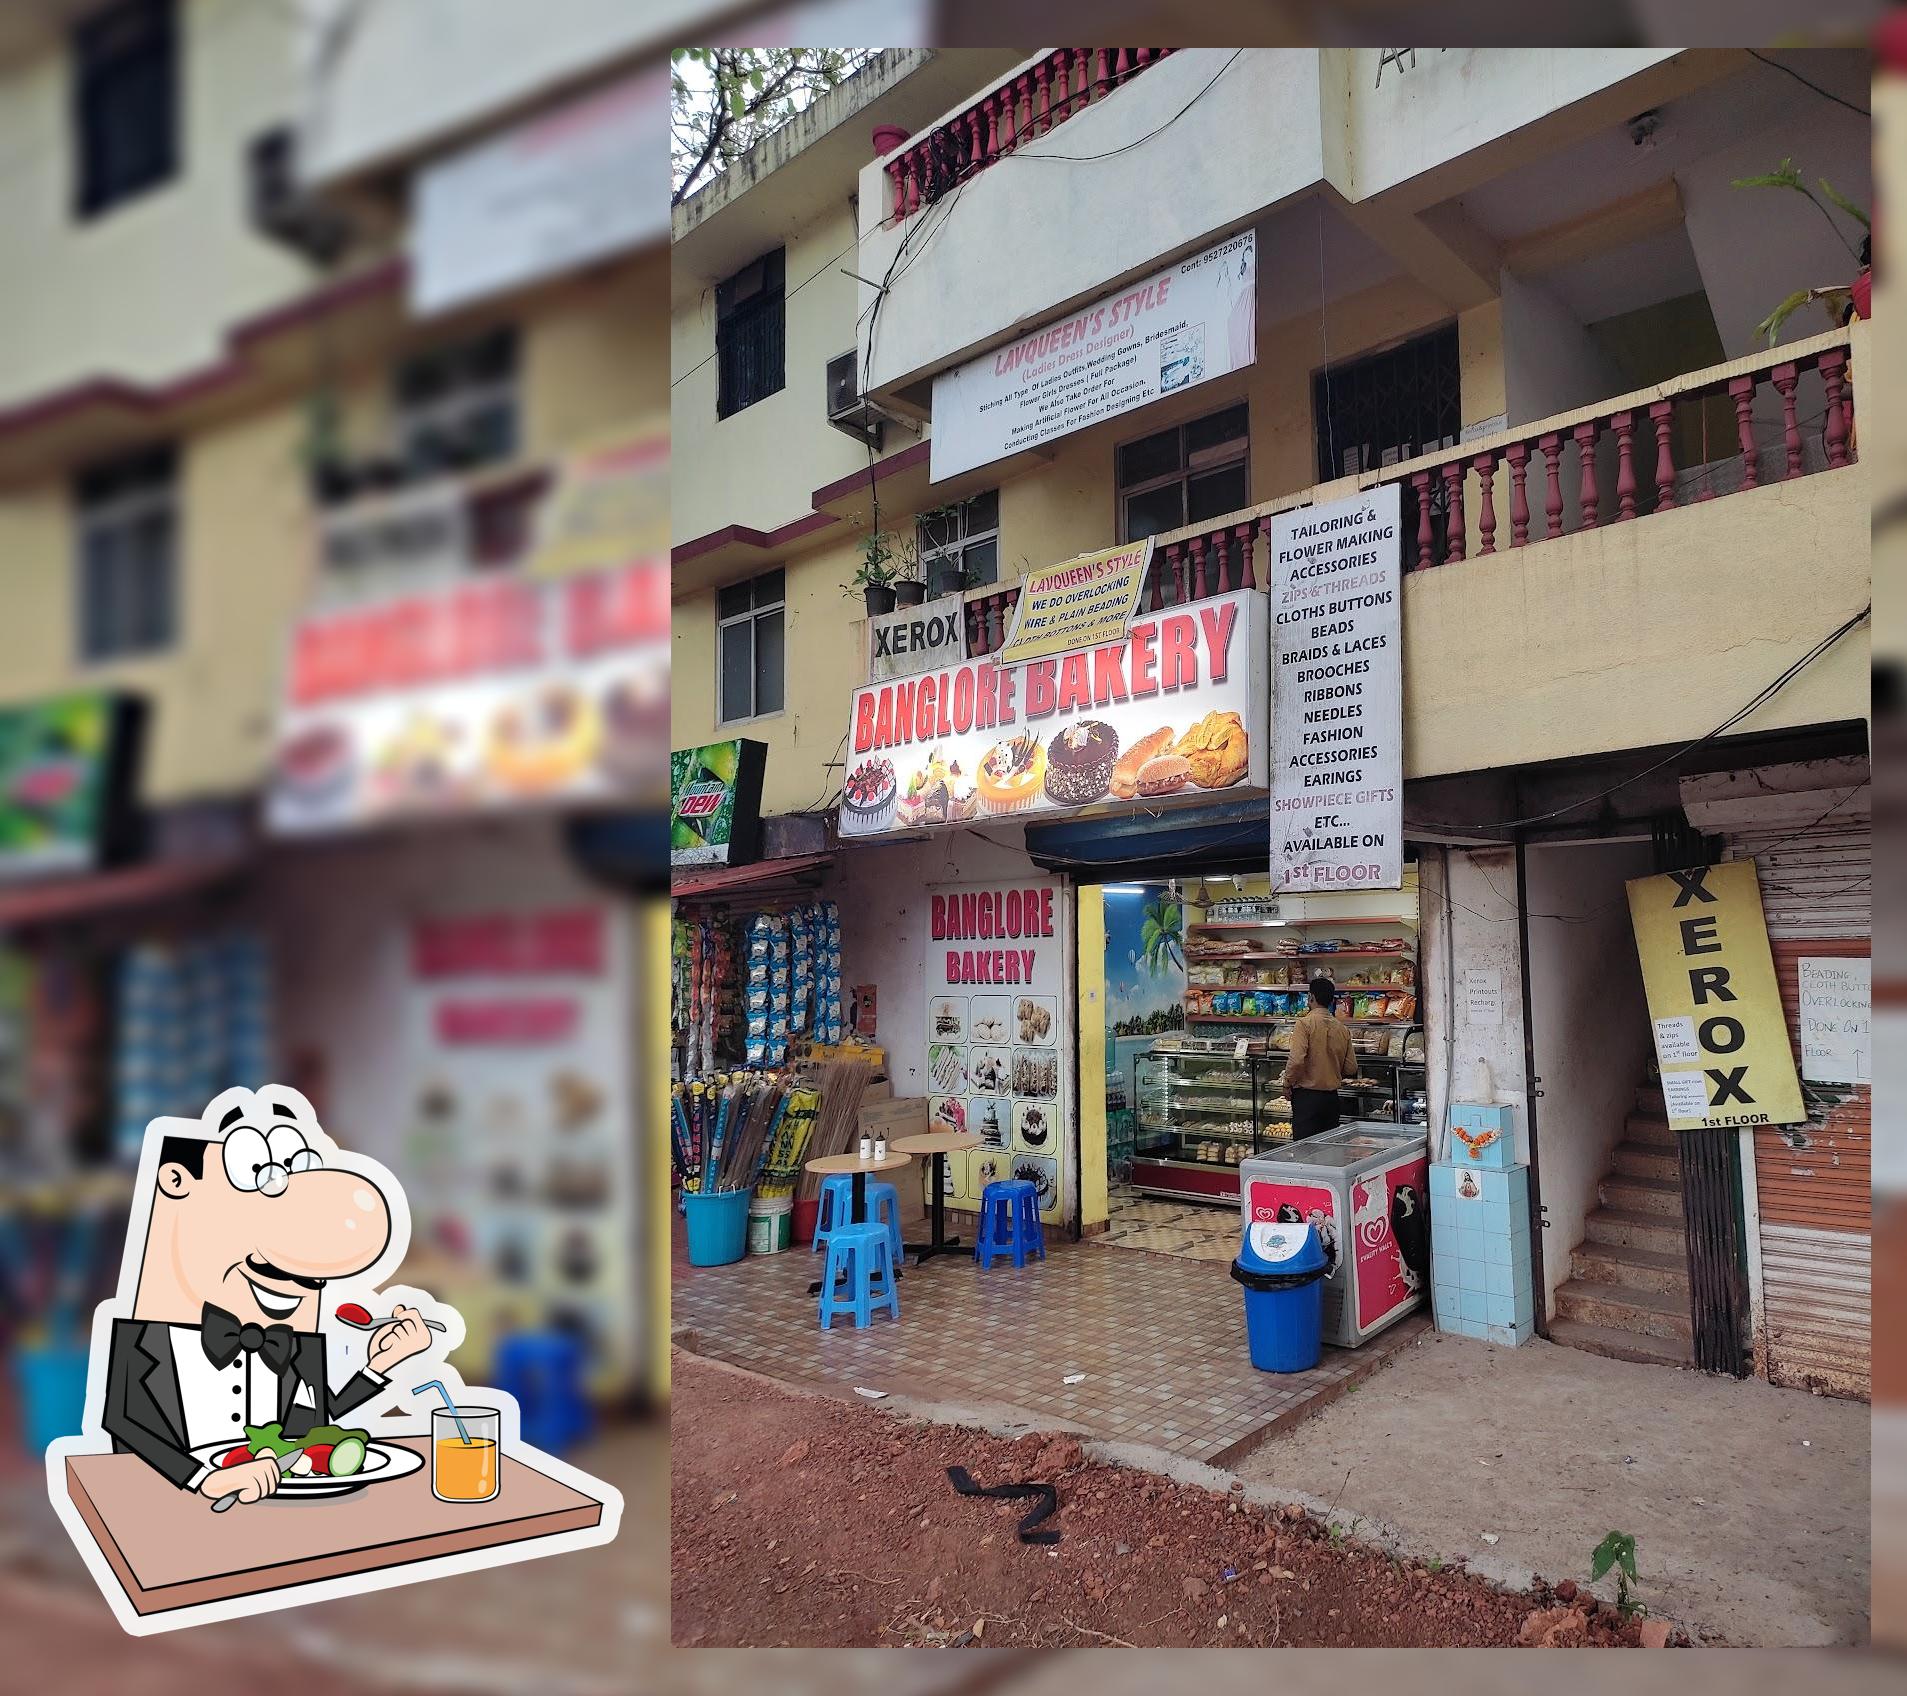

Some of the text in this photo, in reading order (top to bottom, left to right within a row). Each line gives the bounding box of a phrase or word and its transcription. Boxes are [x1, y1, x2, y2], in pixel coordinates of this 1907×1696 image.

[1181, 233, 1253, 275] Cont: 9527220676
[994, 307, 1105, 377] LAVQUEEN'S
[1108, 276, 1172, 329] STYLE
[1022, 359, 1056, 383] (Ladies
[1058, 347, 1084, 367] Dress
[1086, 323, 1135, 355] Designer)
[1004, 394, 1013, 403] All
[1014, 388, 1029, 400] Type
[1031, 382, 1039, 391] Of
[1040, 374, 1062, 388] Ladies
[1019, 396, 1041, 409] Flower
[1042, 388, 1057, 400] Girls
[1058, 377, 1085, 393] Dresses
[1090, 368, 1103, 380] Full
[1104, 355, 1137, 377] Package)
[1038, 377, 1115, 413] We Also Take Order For
[1004, 388, 1155, 450] Conducting Classes For Fashion Designing Etc
[1011, 422, 1034, 435] Making
[1035, 412, 1061, 427] Artificial
[1063, 401, 1086, 415] Flower
[1087, 396, 1099, 407] For
[1100, 390, 1110, 401] All
[1291, 509, 1377, 541] TAILORING &
[1279, 525, 1393, 563] FLOWER MAKING
[1029, 549, 1141, 593] LAVQUEEN'S STYLE
[1289, 551, 1378, 582] ACCESSORIES
[1031, 575, 1130, 611] WE DO OVERLOCKING
[1281, 570, 1386, 604] ZIPS & THREADS
[1024, 593, 1129, 629] WIRE & PLAIN BEADING
[1097, 611, 1128, 626] MORE
[1276, 590, 1393, 625] CLOTHS BUTTONS
[875, 611, 959, 658] XEROX
[1067, 627, 1120, 646] DONE ON 1ST FLOOR
[1311, 619, 1354, 639] BEADS
[1282, 635, 1387, 665] BRAIDS & LACES
[854, 601, 1238, 755] BANGLORE BAKERY
[1297, 659, 1370, 684] BROOCHES
[1304, 682, 1363, 703] RIBBONS
[1304, 704, 1363, 724] NEEDLES
[1303, 725, 1364, 745] FASHION
[1289, 745, 1378, 769] ACCESSORIES
[1303, 769, 1363, 788] EARINGS
[1275, 788, 1394, 812] SHOWPIECE GIFTS
[1314, 814, 1350, 829] ETC...
[1283, 833, 1385, 853] AVAILABLE ON
[1283, 863, 1381, 884] 1st FLOOR
[931, 888, 1054, 940] BANGLORE
[946, 949, 1036, 985] BAKERY
[1666, 866, 1756, 1107] XEROX
[1801, 980, 1836, 990] CLOTH
[1657, 1021, 1684, 1030] Threads
[1666, 1032, 1679, 1040] zips
[1808, 1017, 1838, 1033] DONE
[1843, 1019, 1858, 1033] ON
[1661, 1041, 1690, 1049] available
[1682, 1050, 1698, 1058] floor
[1804, 1043, 1833, 1057] FLOOR
[1702, 1113, 1770, 1127] 1st FLOOR
